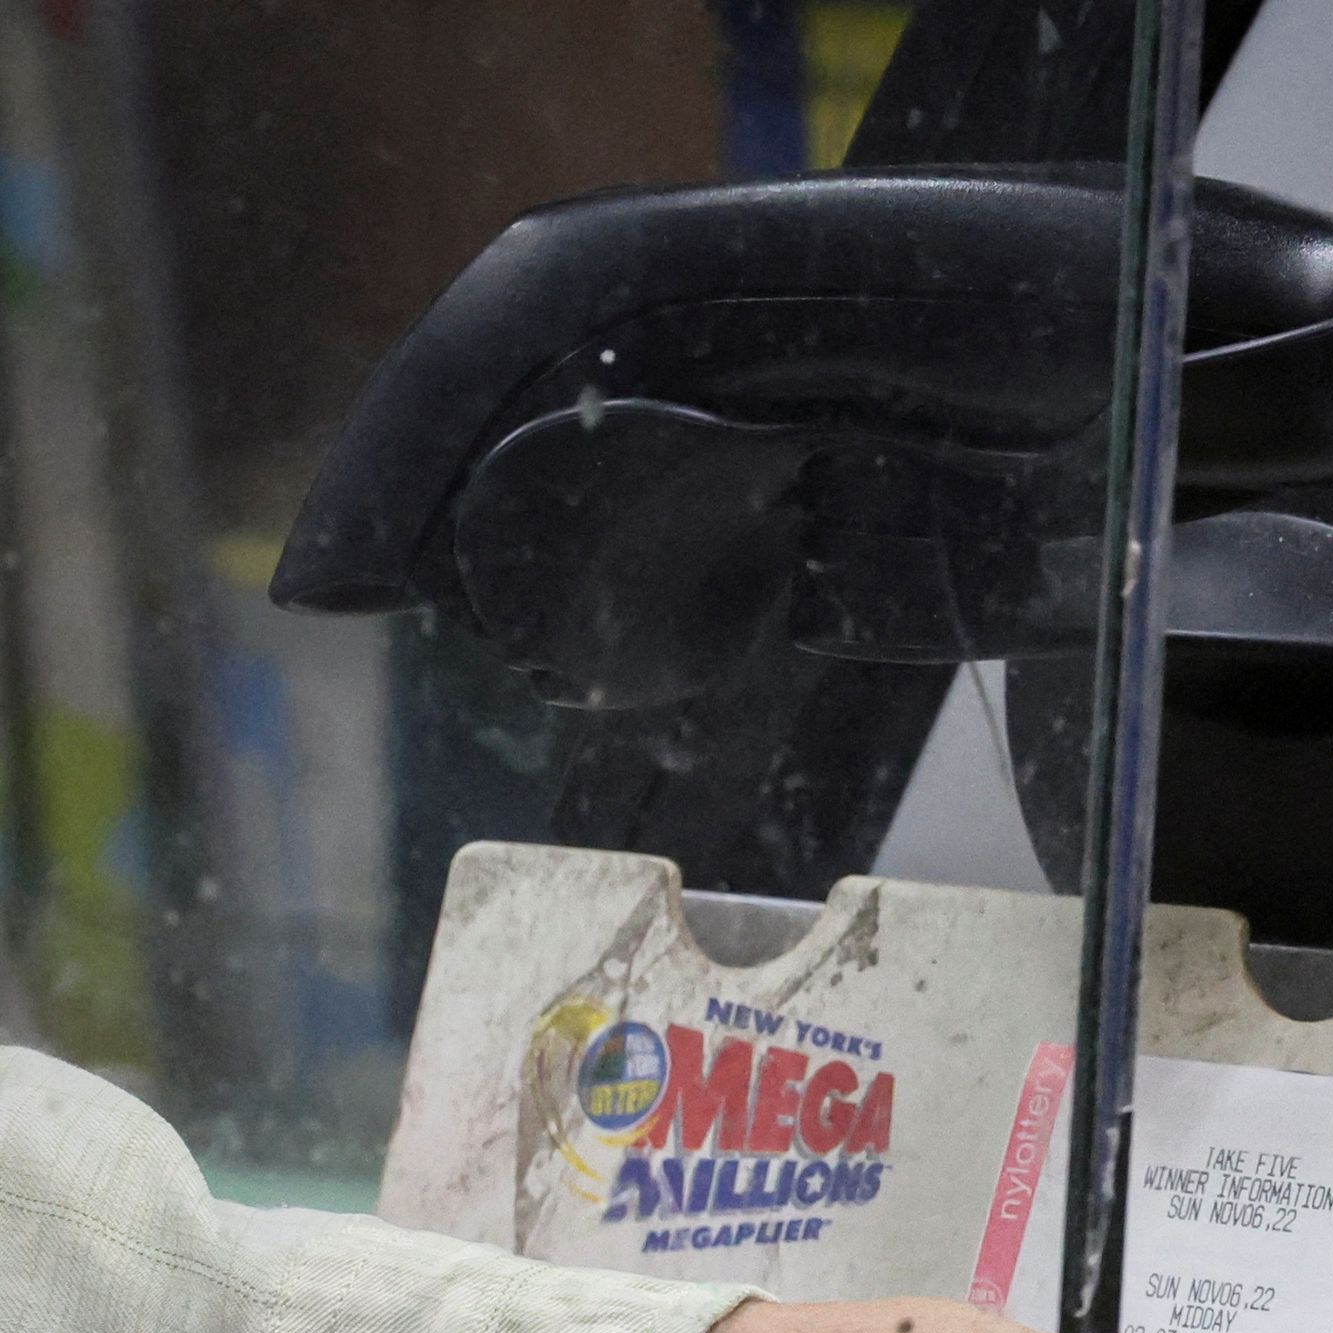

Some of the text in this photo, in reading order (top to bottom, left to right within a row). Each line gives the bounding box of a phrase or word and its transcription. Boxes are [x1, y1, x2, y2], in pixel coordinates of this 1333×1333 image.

[706, 997, 882, 1061] NEW YORK'S
[624, 1023, 895, 1156] MEGA
[1205, 1147, 1302, 1179] TAKE FIVE
[601, 1157, 885, 1223] MILLIONS
[1143, 1165, 1209, 1195] WINNER
[1167, 1194, 1203, 1221] SUN
[641, 1217, 824, 1252] MEGAPLIER
[1145, 1273, 1181, 1299] SUN
[1169, 1304, 1237, 1333] MIDDAY
